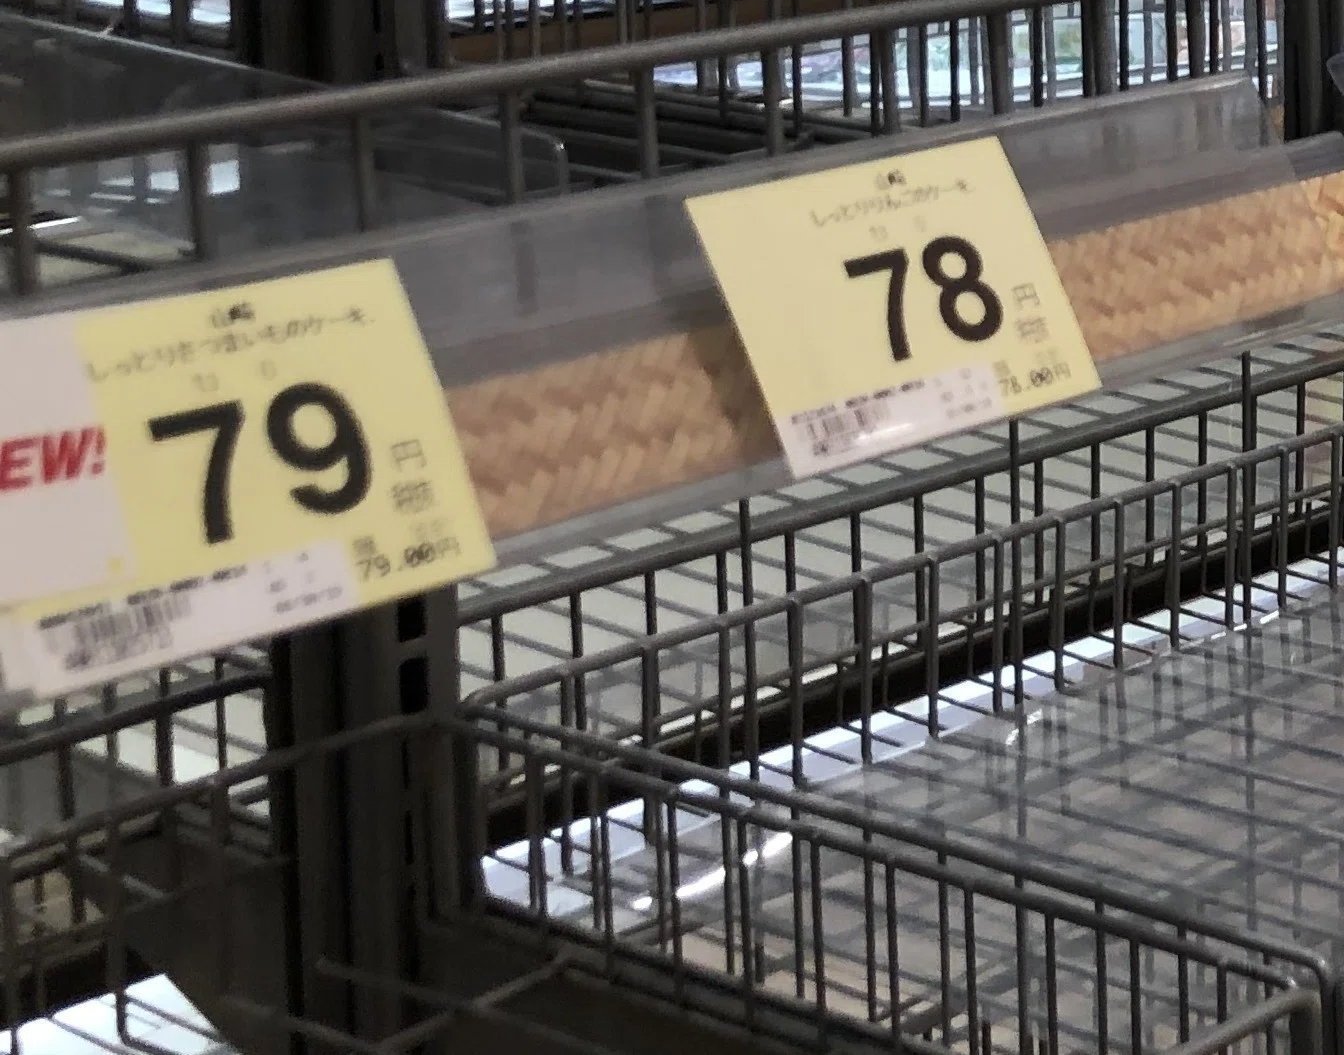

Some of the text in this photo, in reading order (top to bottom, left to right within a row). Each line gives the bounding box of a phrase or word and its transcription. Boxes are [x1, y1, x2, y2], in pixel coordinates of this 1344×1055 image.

[843, 234, 1004, 363] 78
[0, 424, 108, 492] EW!
[147, 381, 374, 546] 79
